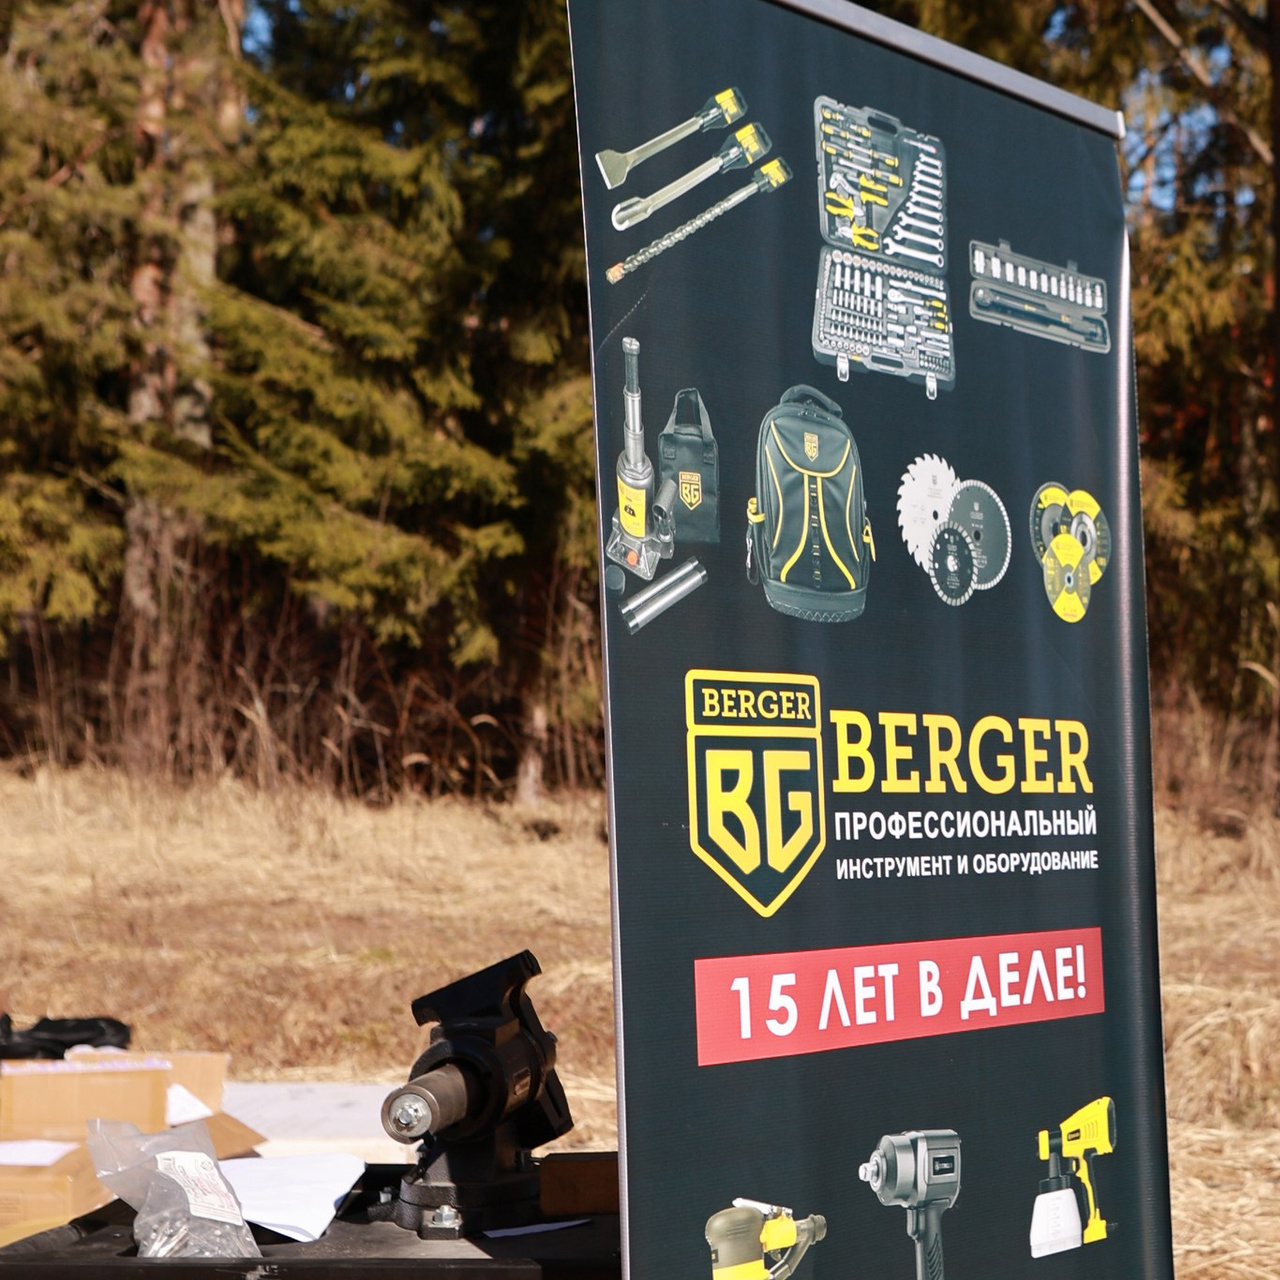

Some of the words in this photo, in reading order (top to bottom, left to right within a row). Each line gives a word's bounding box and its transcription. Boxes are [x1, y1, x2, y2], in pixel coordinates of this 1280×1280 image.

[682, 483, 700, 504] BG
[701, 687, 812, 720] BERGER
[829, 709, 1094, 795] BERGER
[705, 749, 813, 875] BG
[834, 805, 1098, 841] ПРОФЕССИОНАЛЬНЫЙ
[836, 855, 952, 880] ИНСТРУМЕНТ
[957, 856, 969, 876] И
[973, 850, 1099, 876] ОБОРУДОВАНИЕ
[729, 973, 798, 1040] 15
[818, 963, 899, 1031] ЛЕТ
[918, 959, 944, 1018] В
[960, 944, 1087, 1020] ДЕЛЕ!
